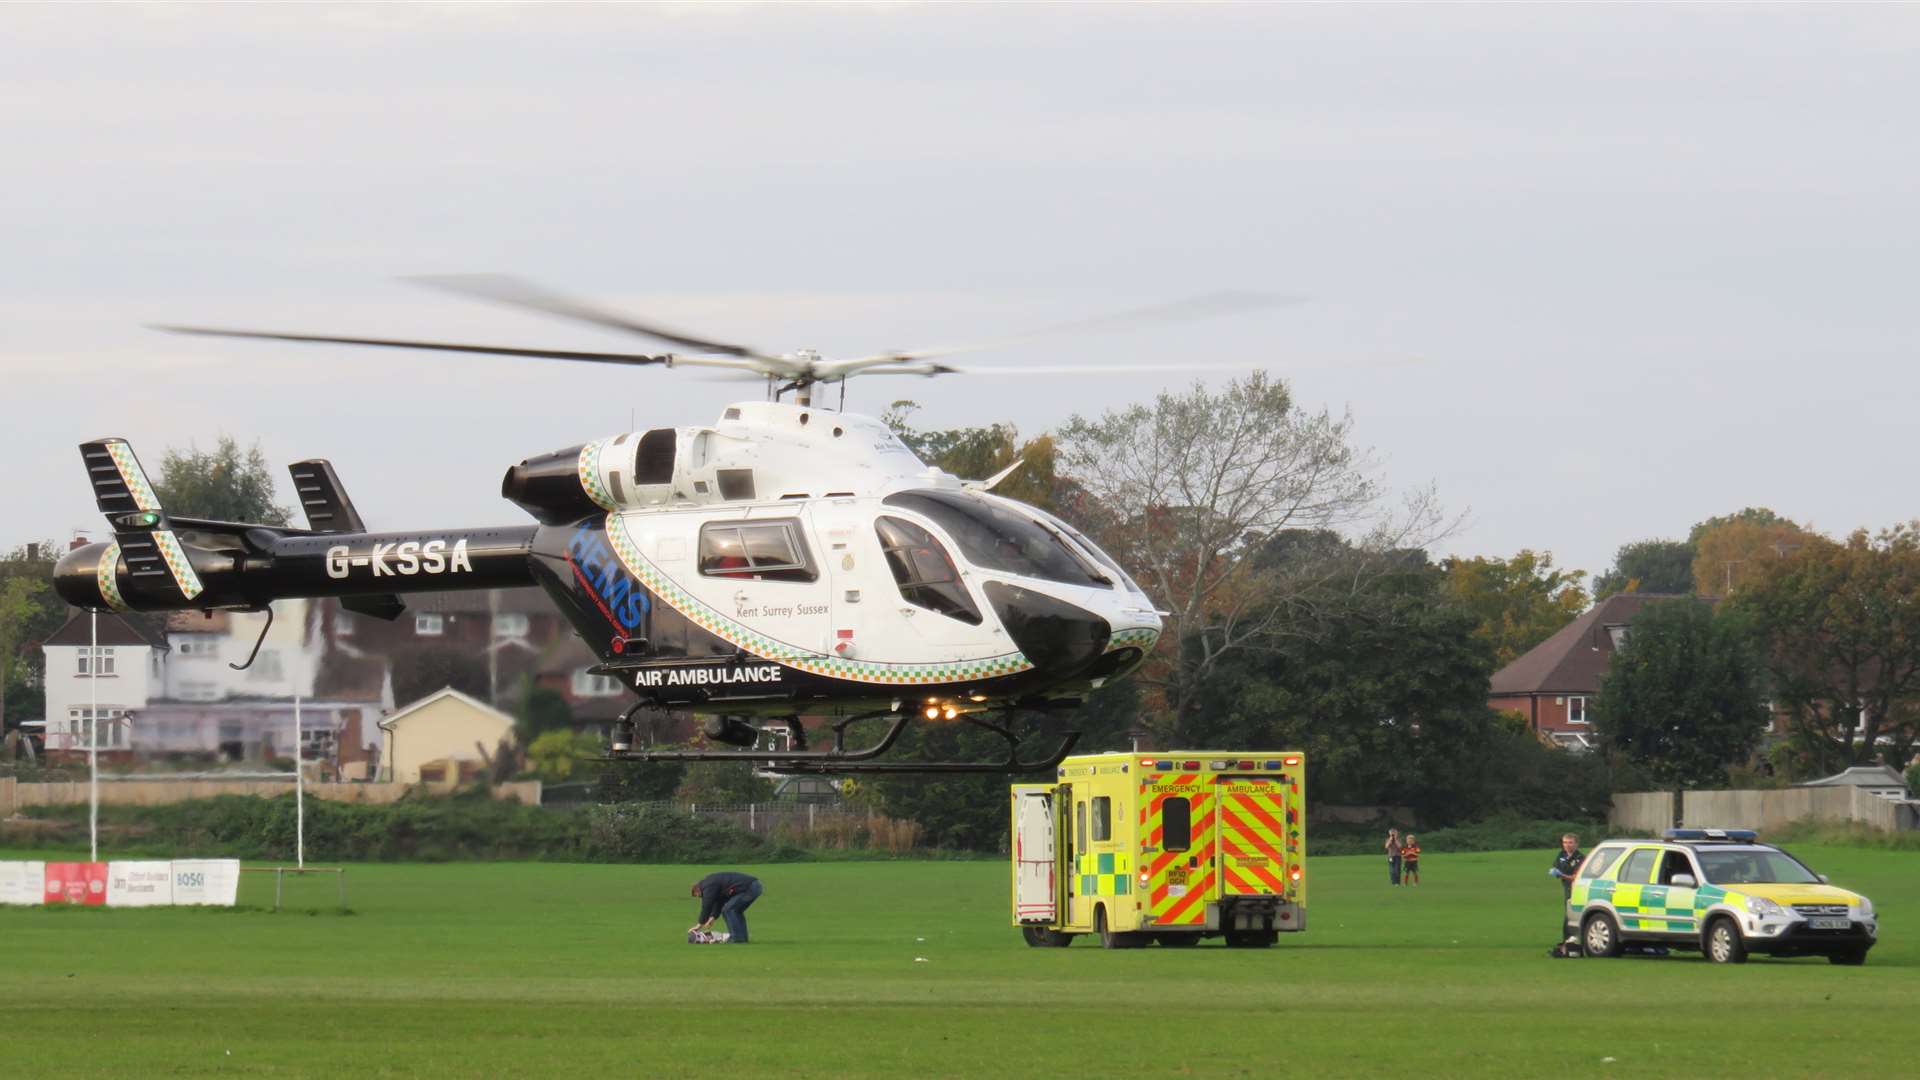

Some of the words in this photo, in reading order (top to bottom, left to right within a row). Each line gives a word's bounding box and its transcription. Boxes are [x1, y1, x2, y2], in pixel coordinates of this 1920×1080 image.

[326, 538, 473, 579] G-KSSA
[567, 521, 651, 629] HEMS
[736, 606, 759, 618] Kent
[762, 605, 793, 619] Surrey
[796, 603, 829, 616] Sussex
[635, 669, 662, 686] AIR
[667, 666, 782, 685] AMBULANCE
[1151, 784, 1201, 793] EMERGENCY
[1226, 784, 1276, 794] AMBULANCE
